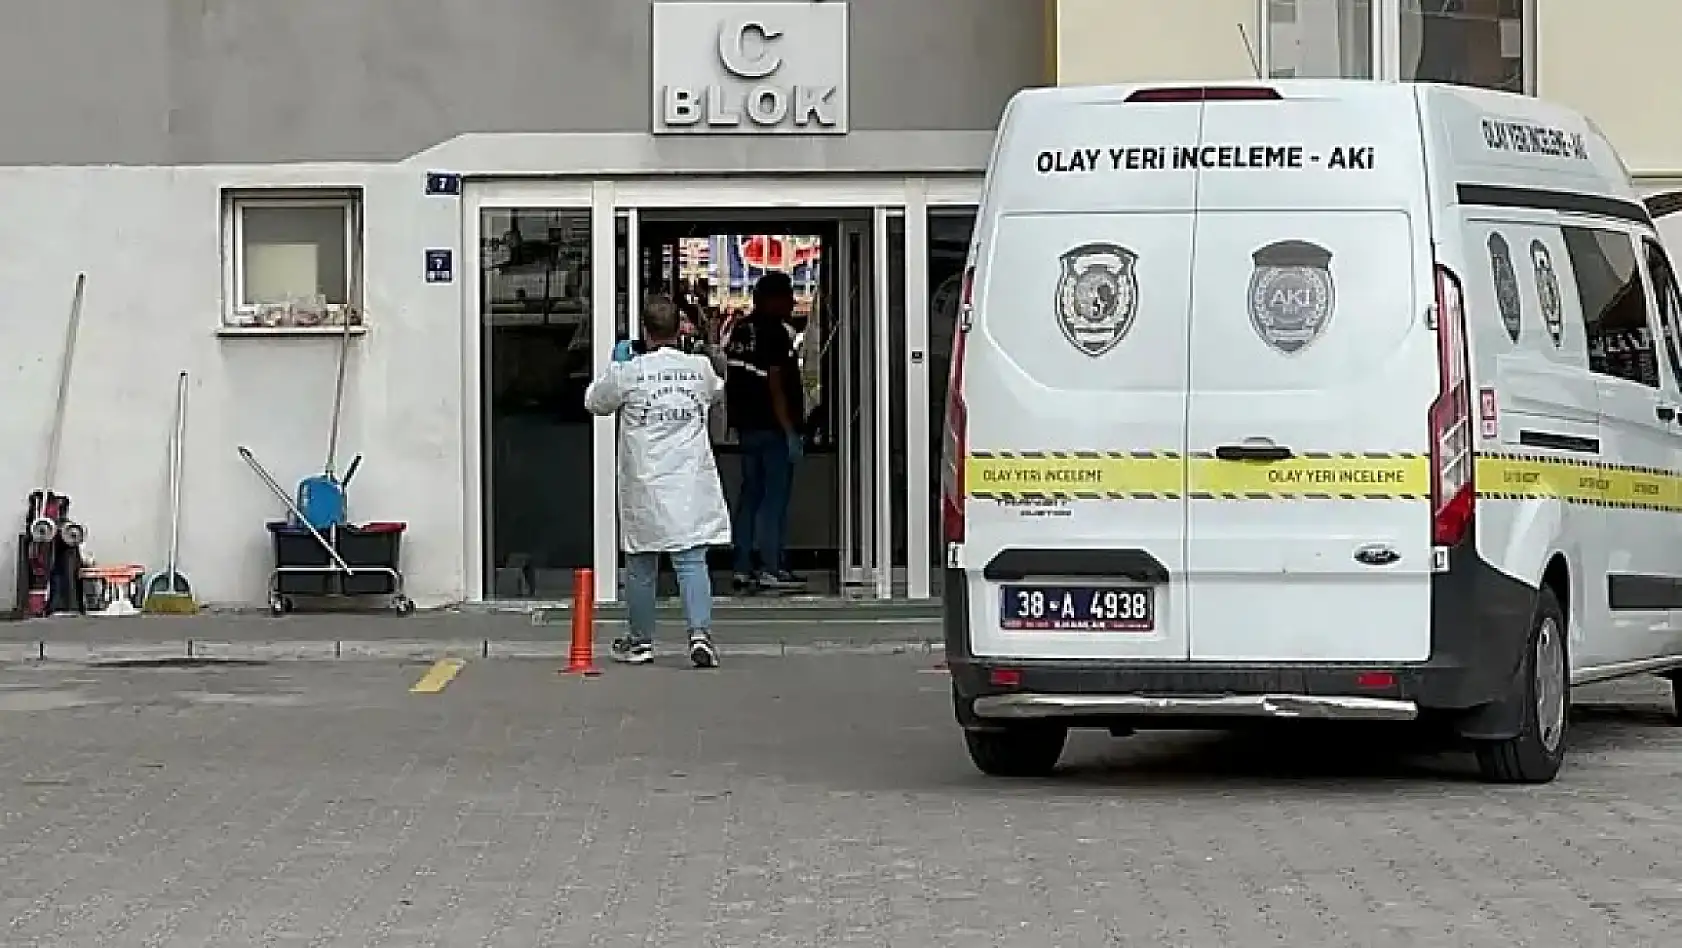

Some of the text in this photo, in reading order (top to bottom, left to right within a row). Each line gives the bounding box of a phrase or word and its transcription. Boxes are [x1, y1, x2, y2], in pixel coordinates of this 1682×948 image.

[717, 20, 784, 79] C
[664, 85, 837, 127] BLOK
[1037, 149, 1100, 172] OLAY
[983, 469, 1010, 483] OLAY
[1268, 469, 1302, 483] OLAY
[1017, 590, 1147, 619] 38 A 4938
